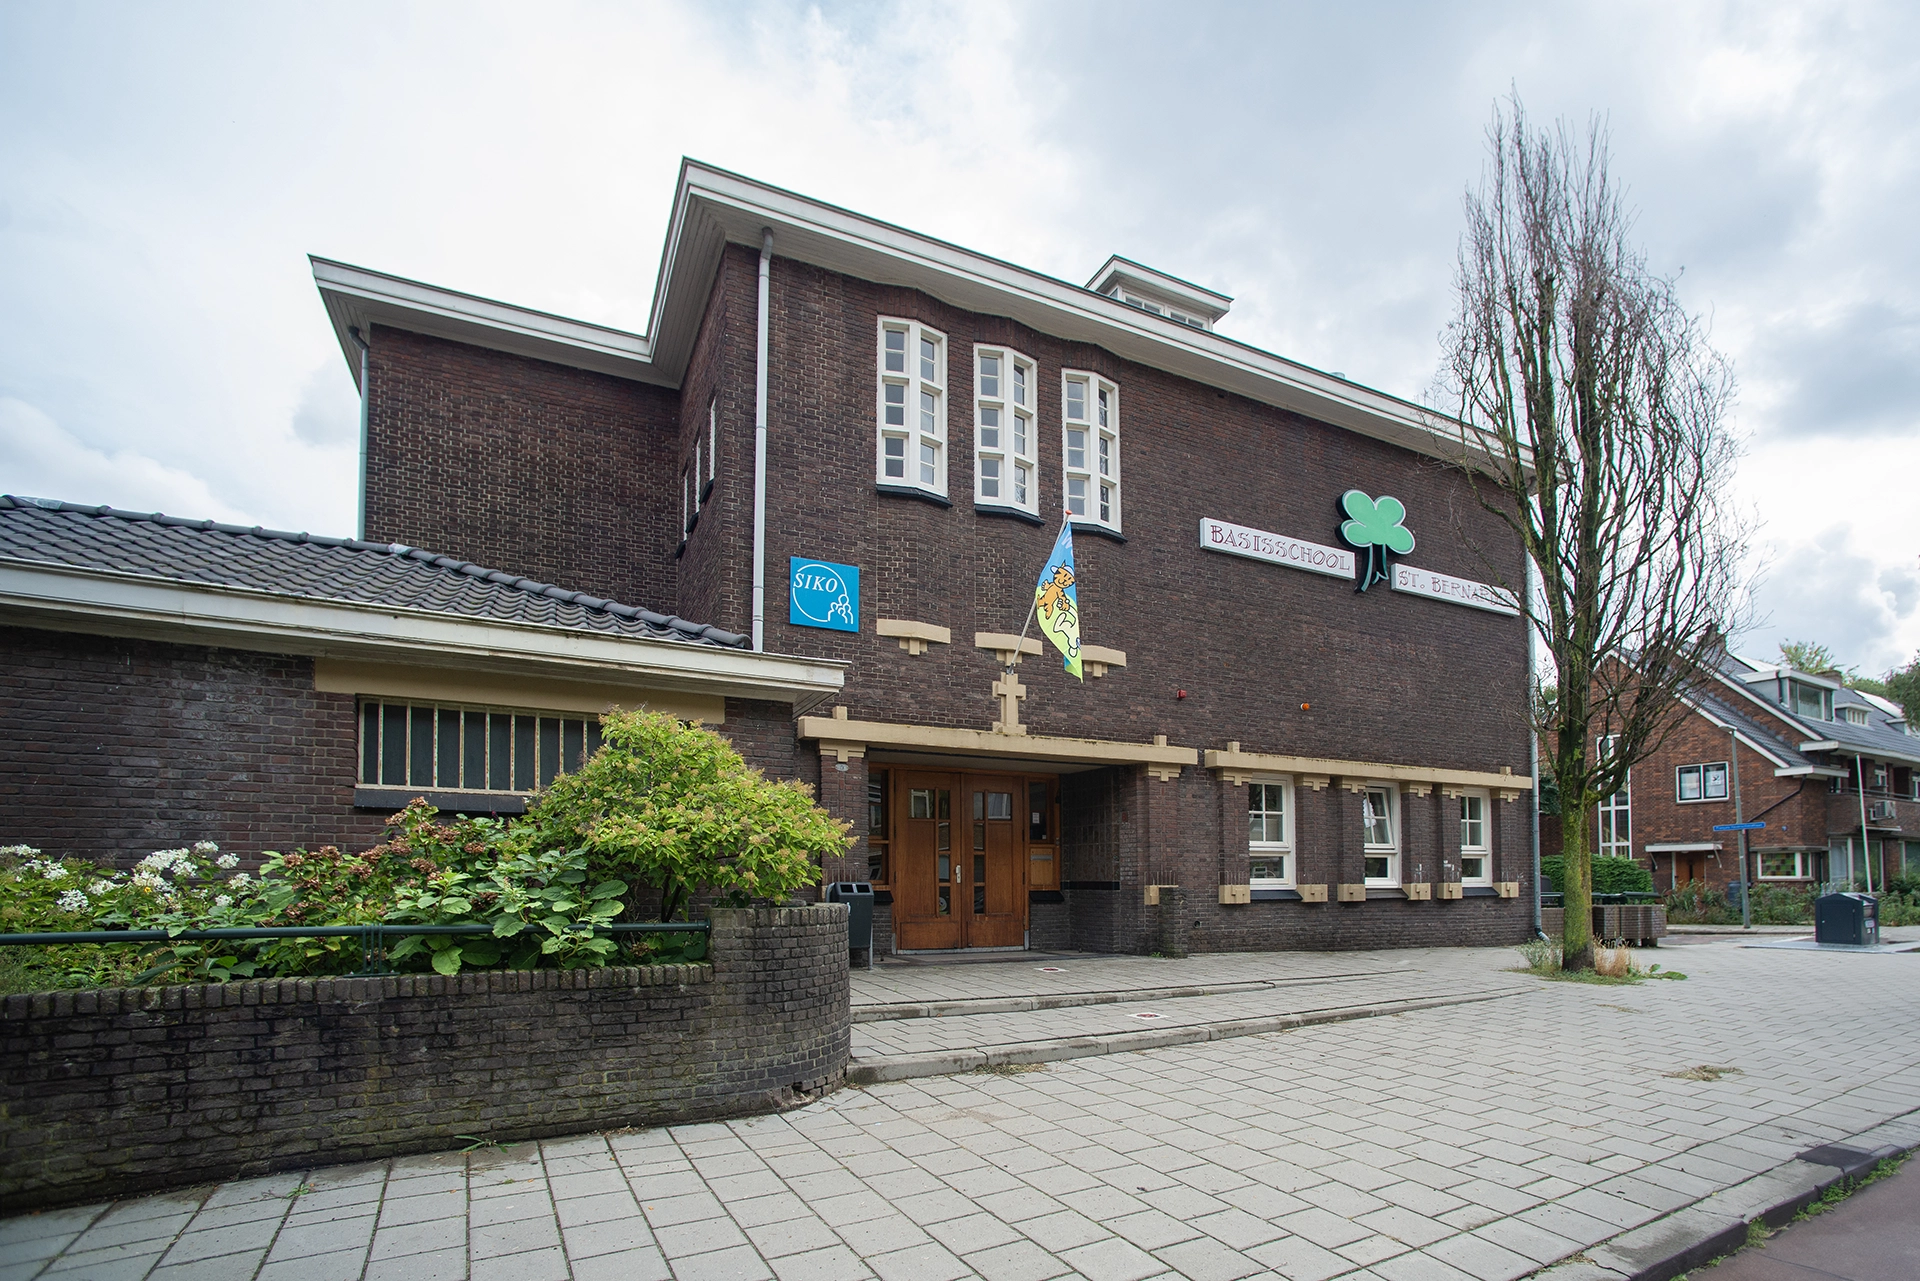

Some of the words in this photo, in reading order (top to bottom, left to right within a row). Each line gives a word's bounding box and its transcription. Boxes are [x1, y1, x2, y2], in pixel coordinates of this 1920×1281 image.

[1210, 524, 1351, 571] BASISSCHOOL
[793, 573, 838, 593] SIKO
[1398, 570, 1426, 590] ST.
